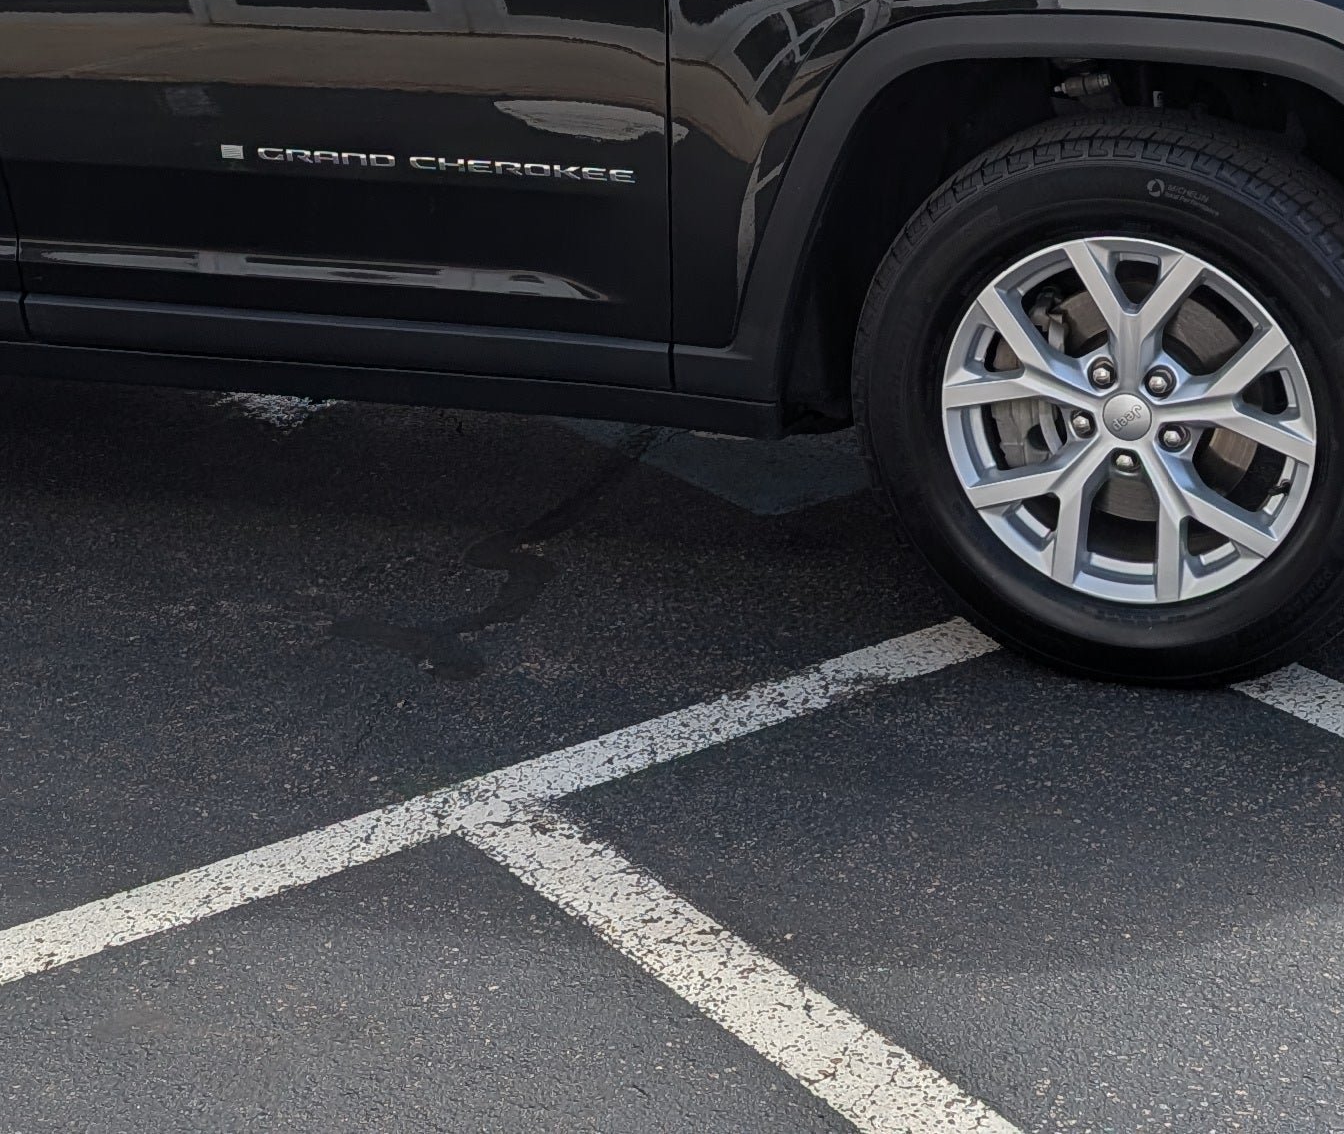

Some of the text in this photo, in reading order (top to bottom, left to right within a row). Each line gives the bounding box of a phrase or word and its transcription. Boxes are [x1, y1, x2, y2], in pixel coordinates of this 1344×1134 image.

[257, 146, 636, 184] GRAND CHEROKEE
[1111, 404, 1142, 432] Jeep
